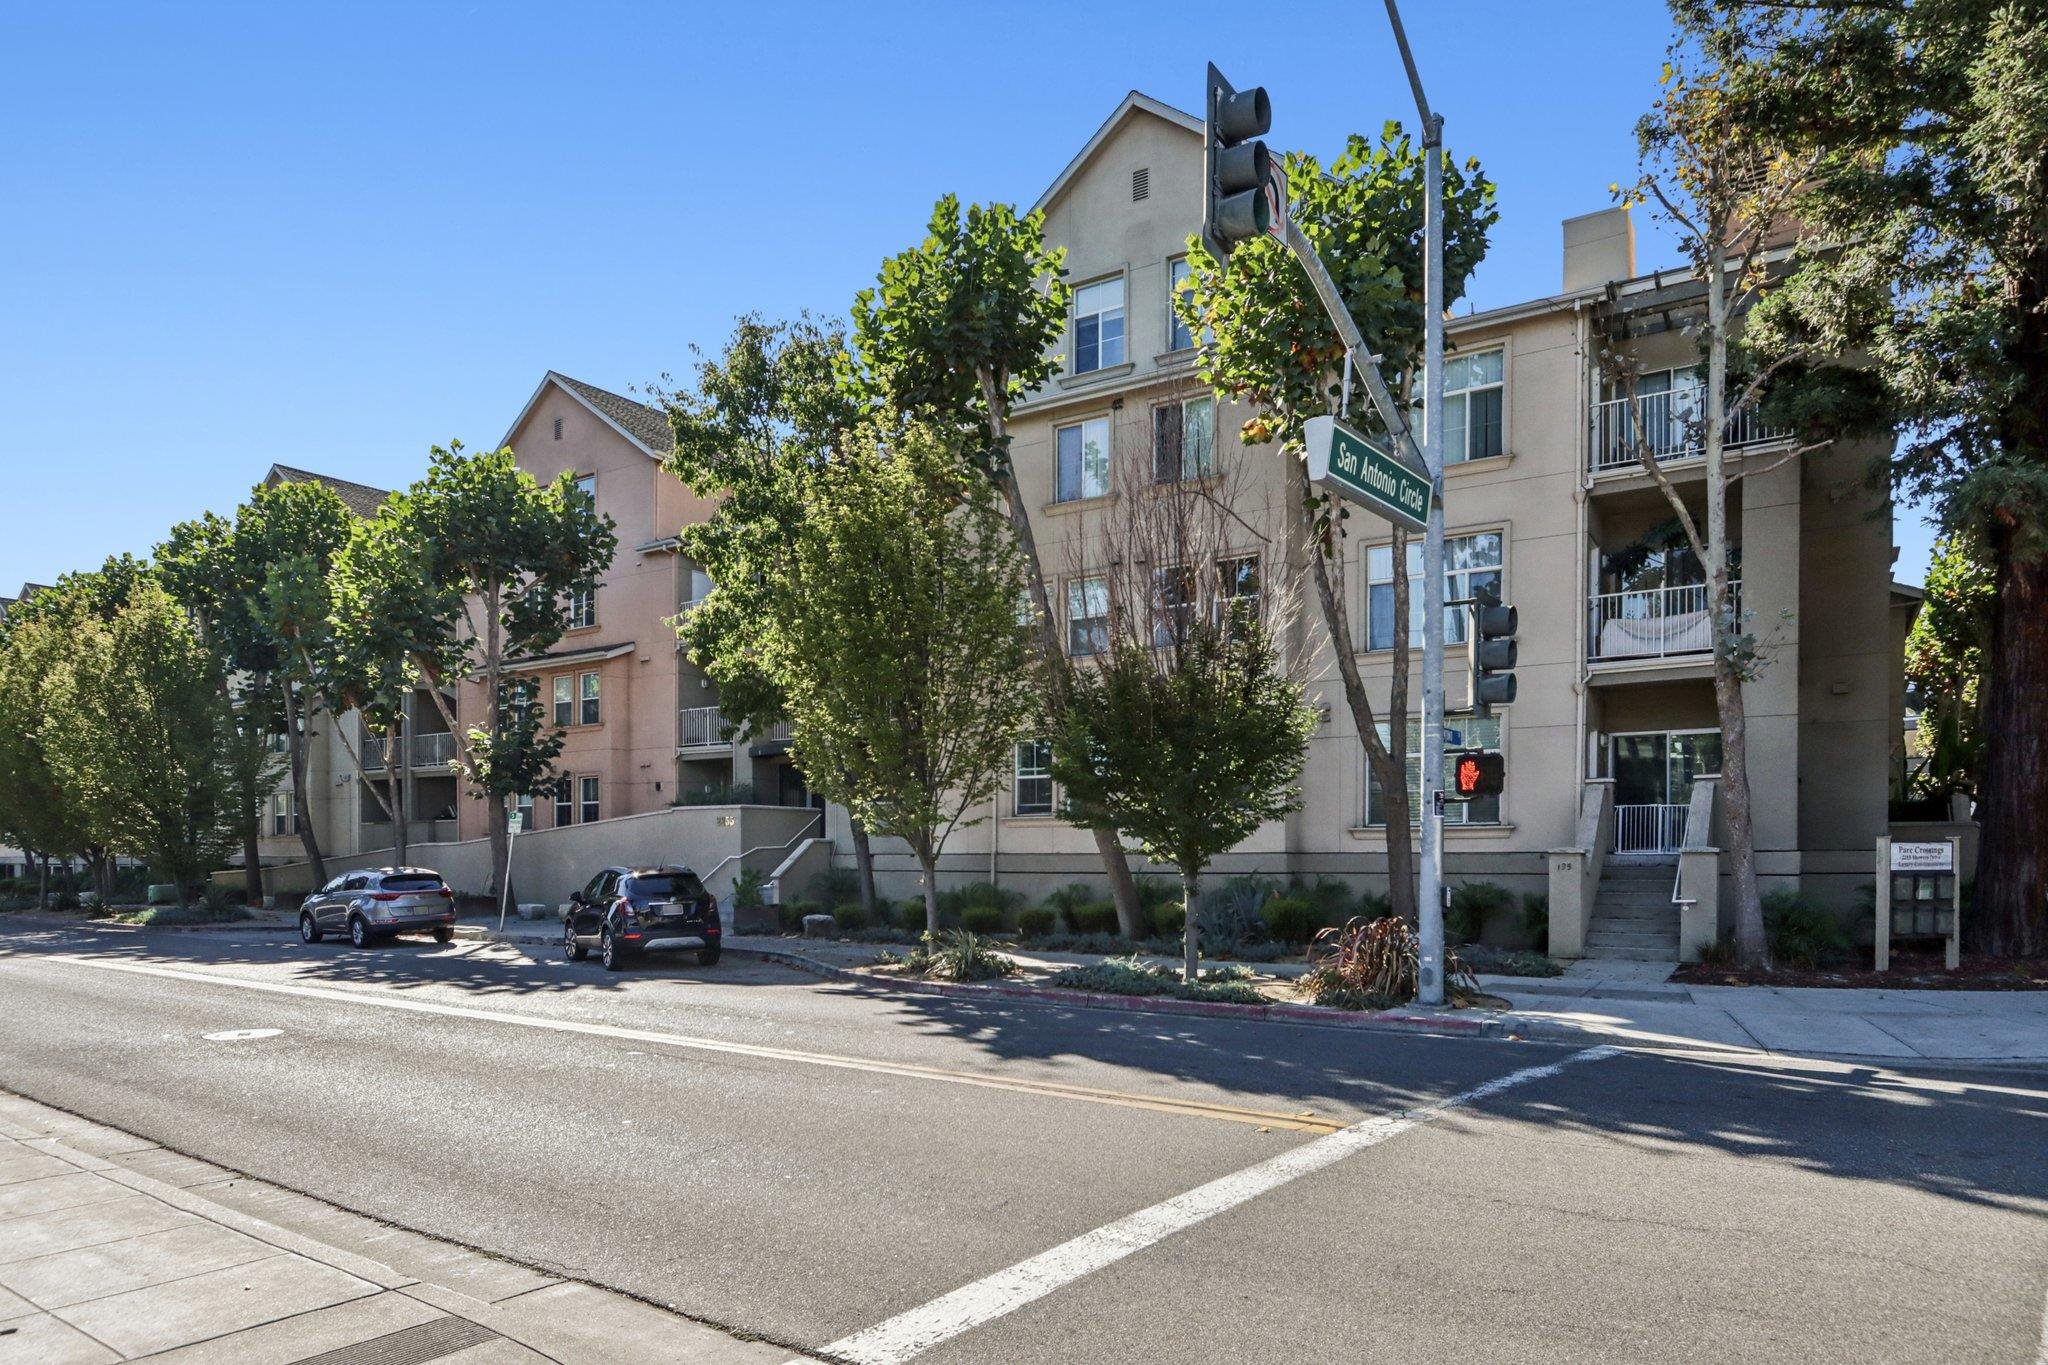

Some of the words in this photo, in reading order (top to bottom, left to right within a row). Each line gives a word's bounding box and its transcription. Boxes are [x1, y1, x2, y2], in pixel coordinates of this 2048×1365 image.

[1338, 442, 1357, 475] San
[1361, 456, 1396, 497] Antonio
[1400, 479, 1423, 512] Circle
[1557, 862, 1572, 871] 195
